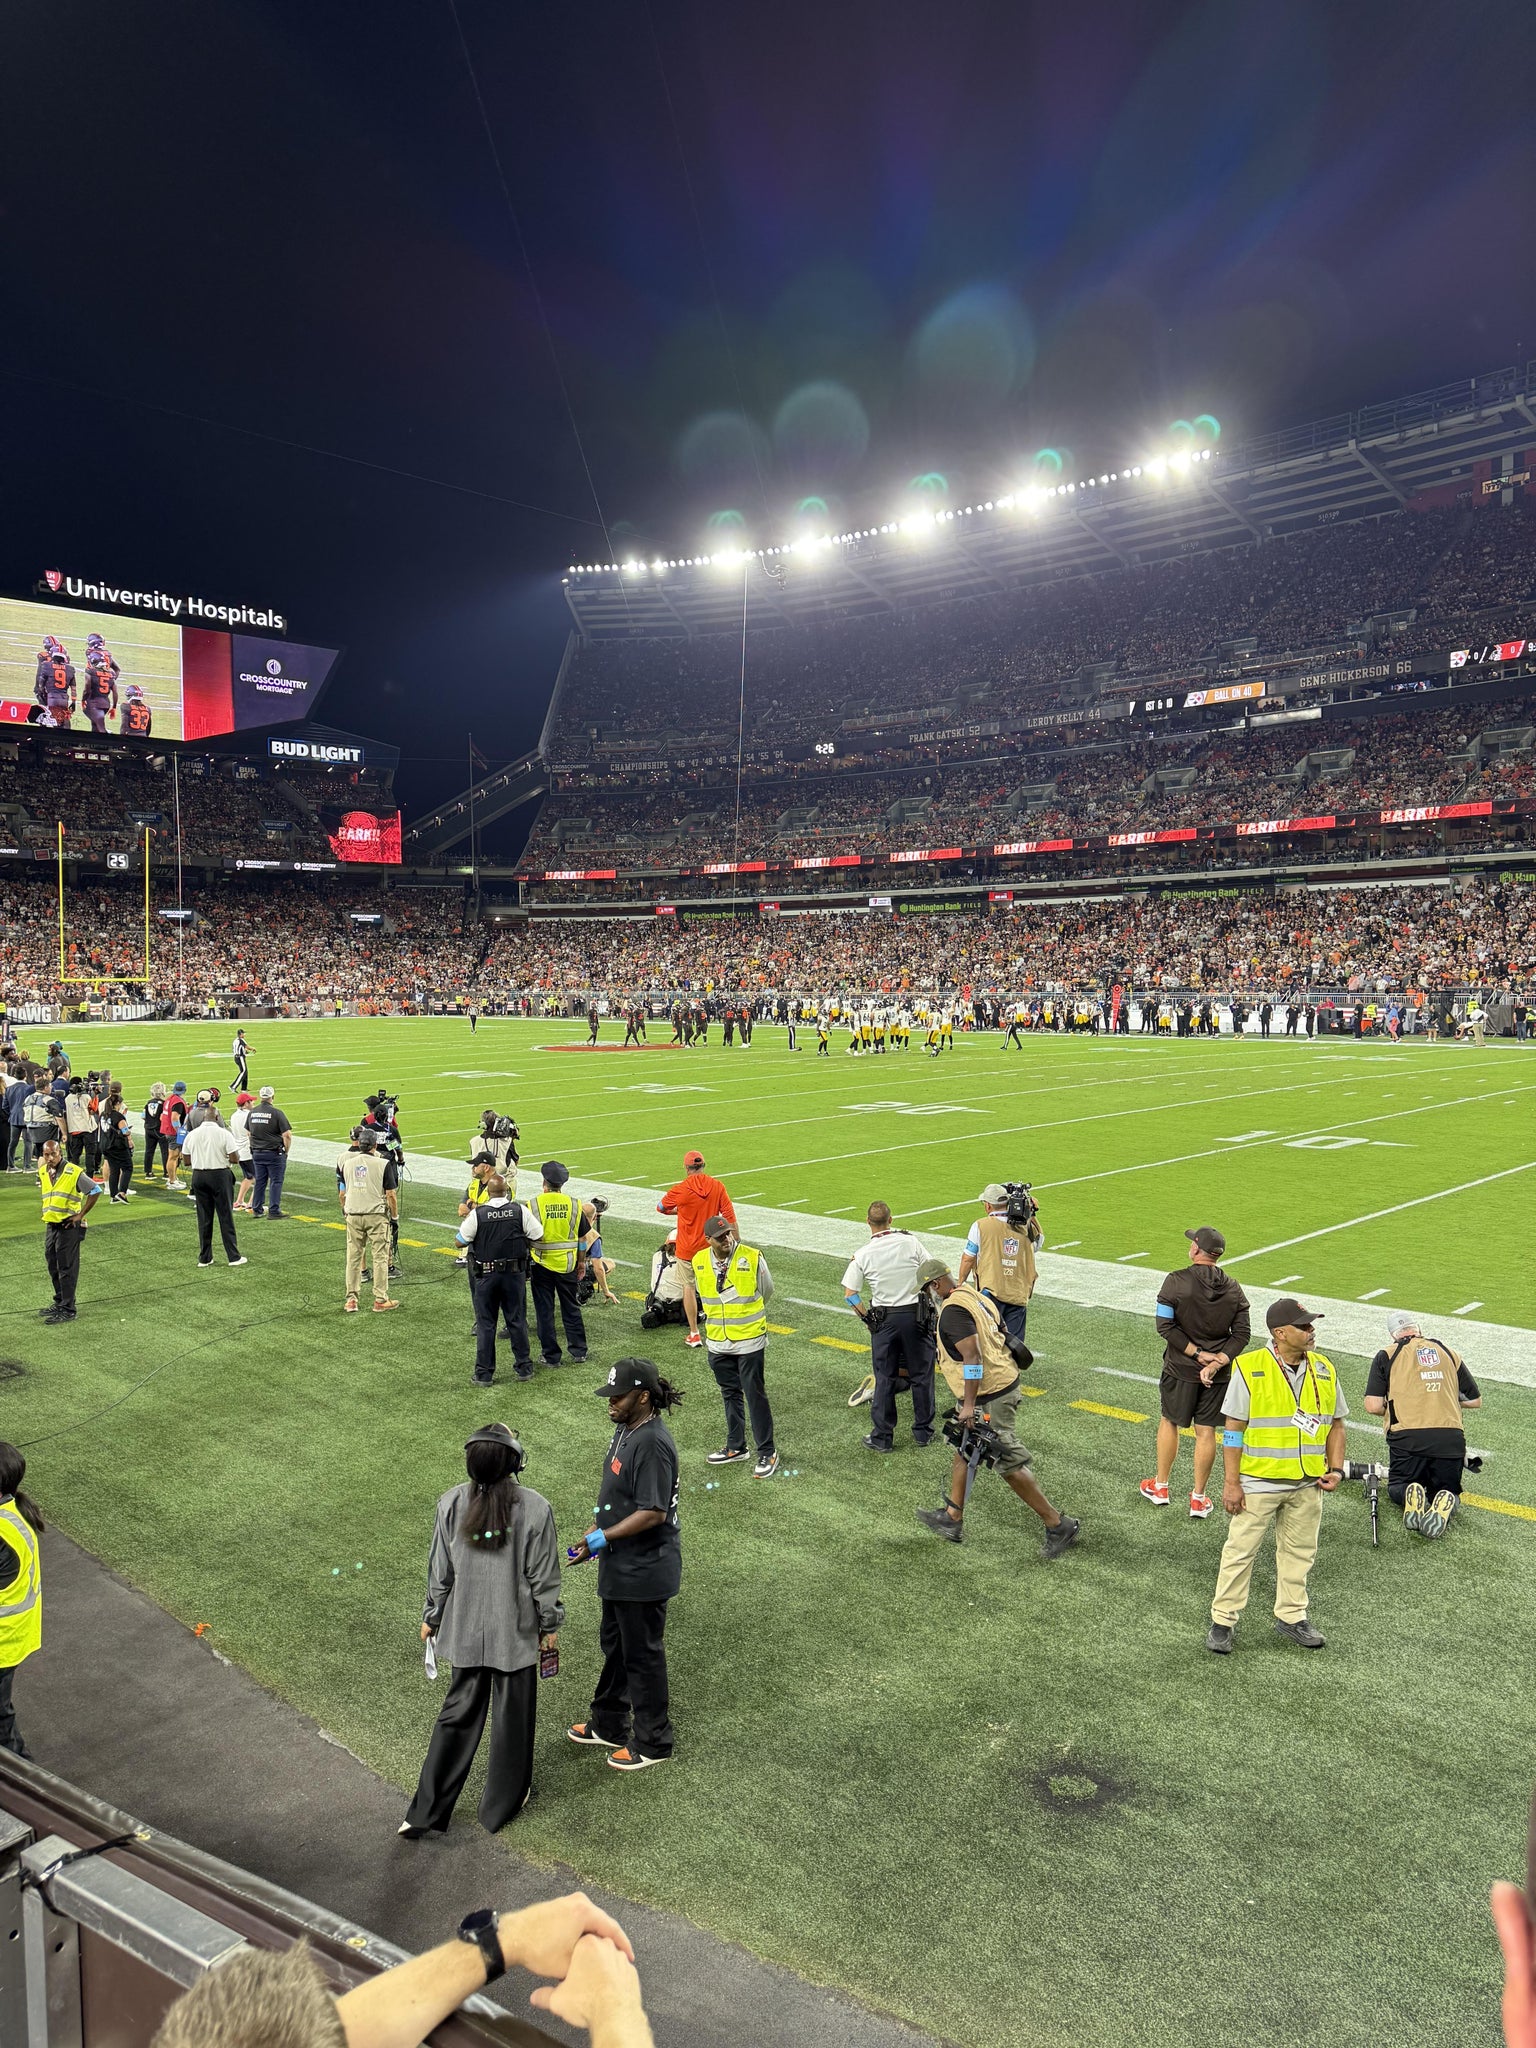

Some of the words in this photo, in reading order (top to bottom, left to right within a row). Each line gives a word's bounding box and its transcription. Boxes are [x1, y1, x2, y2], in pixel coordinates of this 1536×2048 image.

[66, 576, 182, 616] University
[188, 597, 283, 629] Hospitals
[1473, 651, 1479, 660] 0
[54, 669, 67, 689] 9
[1300, 674, 1327, 688] GENE
[1329, 664, 1390, 684] HICKERSON
[1396, 660, 1412, 674] 66
[99, 676, 110, 694] 5
[239, 673, 308, 690] CROSSCOUNTRY
[256, 683, 294, 695] MORTGAGE
[1214, 690, 1229, 701] BALL
[1231, 688, 1241, 698] ON
[1243, 686, 1252, 697] 40
[10, 705, 18, 718] 0
[1027, 716, 1054, 728] LEROY
[1056, 711, 1085, 724] KELLY
[1088, 708, 1101, 719] 44
[129, 709, 150, 730] 33
[909, 731, 935, 743] FRANK
[936, 728, 965, 739] GATSKI
[968, 725, 981, 736] 52
[271, 740, 309, 757] BUD
[311, 744, 361, 762] LIGHT
[815, 743, 835, 754] 9:26
[239, 766, 257, 774] BUD
[610, 761, 669, 772] CHAMPIONSHIPS
[674, 760, 686, 768] '46
[109, 854, 127, 867] 25
[909, 903, 944, 913] Huntington
[945, 902, 962, 910] Bank
[6, 1005, 51, 1024] DAWG
[112, 1004, 156, 1021] POUN
[487, 1209, 514, 1220] POLICE
[545, 1204, 569, 1212] CLEVELAND
[546, 1211, 568, 1220] POLICE
[1420, 1355, 1438, 1364] NFL
[1420, 1371, 1444, 1381] MEDIA
[1425, 1382, 1442, 1393] 227
